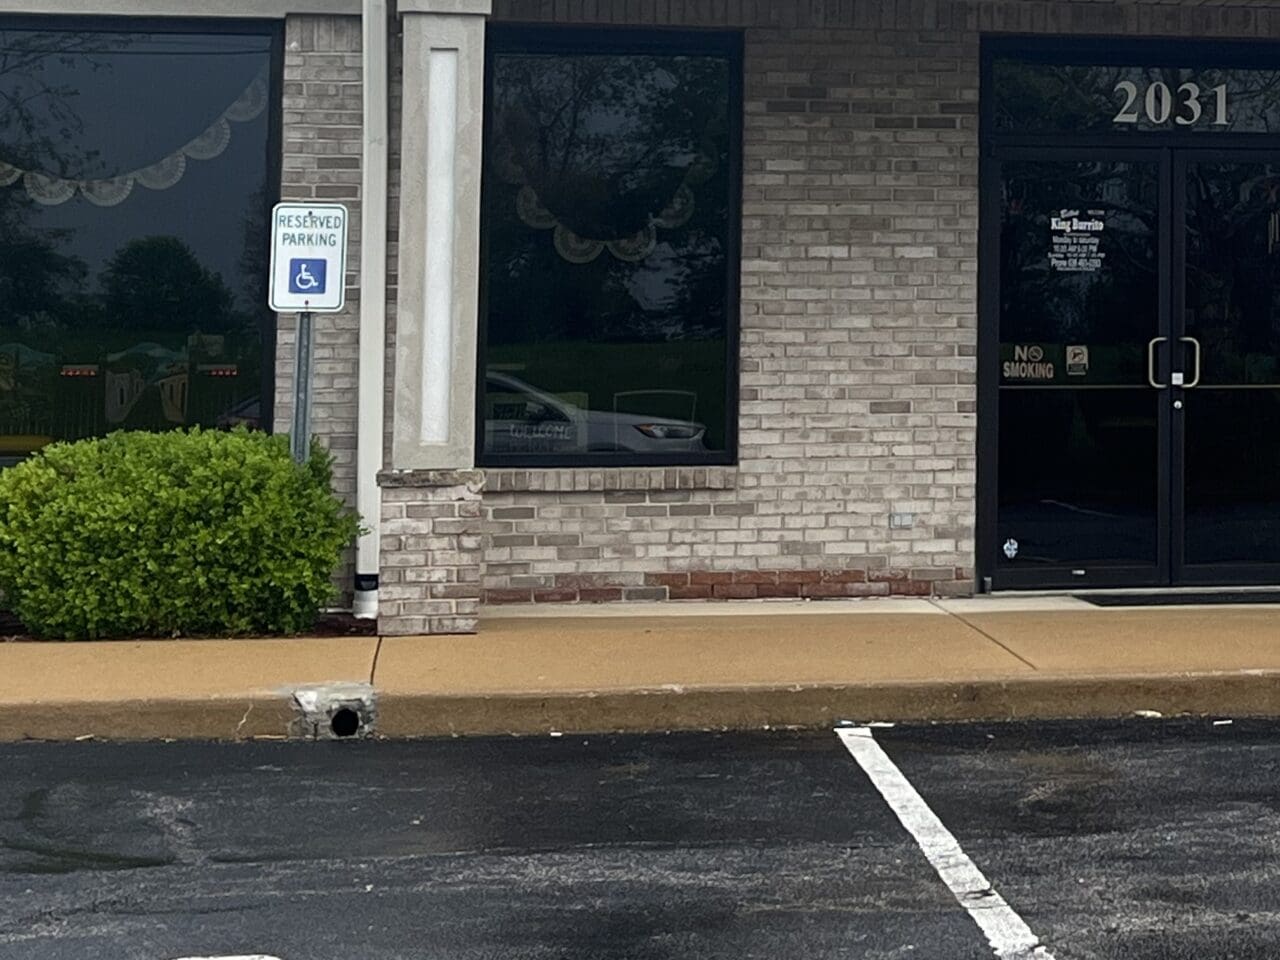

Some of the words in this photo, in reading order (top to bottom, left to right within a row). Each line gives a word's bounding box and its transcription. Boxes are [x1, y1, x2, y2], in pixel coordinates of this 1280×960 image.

[1113, 81, 1231, 125] 2031
[279, 215, 341, 229] RESERVED
[1051, 218, 1071, 232] King
[1072, 218, 1104, 231] Burrito
[282, 233, 336, 246] PARKING
[1014, 345, 1043, 362] NO
[1003, 361, 1054, 379] SMOKING
